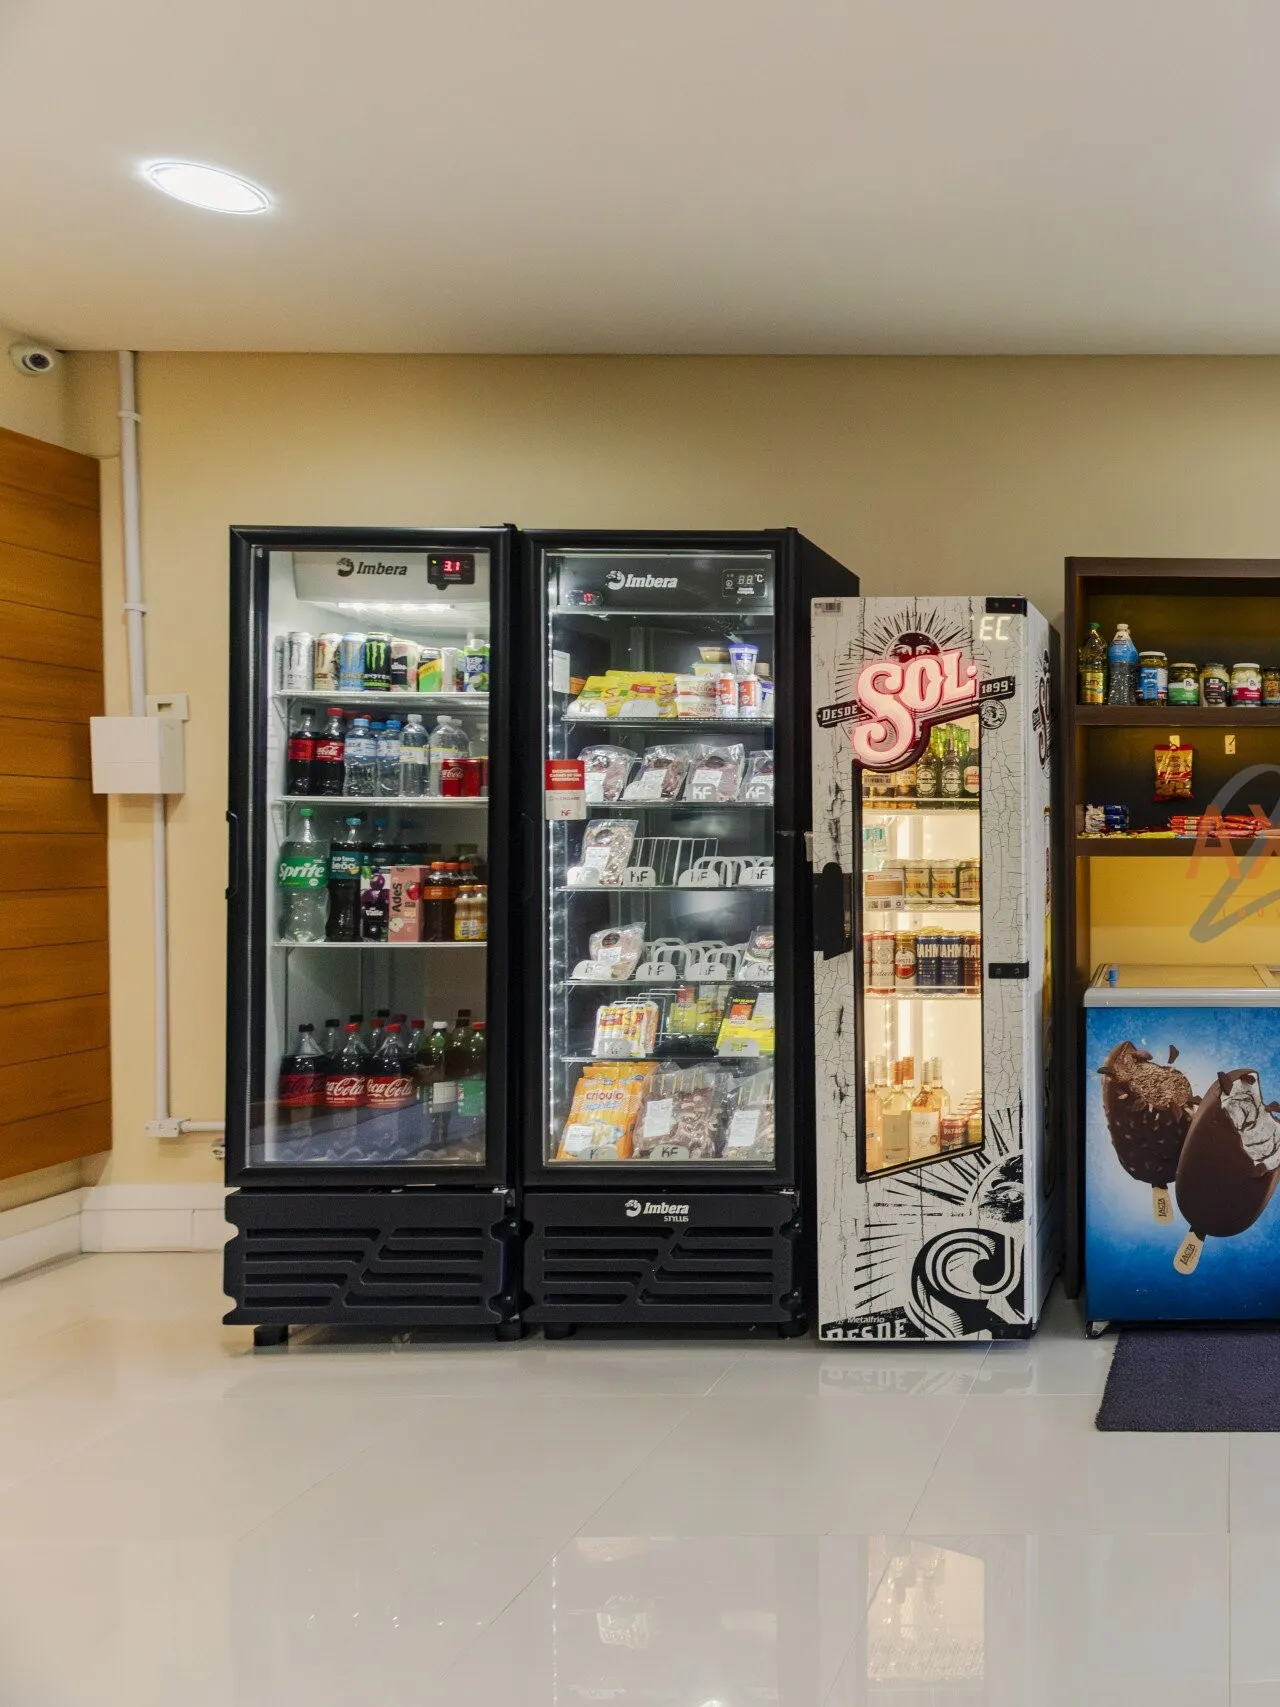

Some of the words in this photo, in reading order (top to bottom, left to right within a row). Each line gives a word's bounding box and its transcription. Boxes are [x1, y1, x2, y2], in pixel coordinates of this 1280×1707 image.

[356, 561, 408, 576] Imbera
[625, 574, 678, 588] Imbera
[981, 680, 1010, 694] 1899
[822, 706, 859, 721] DESDE
[853, 651, 978, 765] SOL
[692, 786, 712, 800] KF
[279, 863, 325, 879] Sprite
[643, 1202, 689, 1215] Imbera
[1158, 1197, 1167, 1217] LACTA
[1180, 1243, 1196, 1266] LACTA
[847, 1316, 885, 1324] Metalfrio
